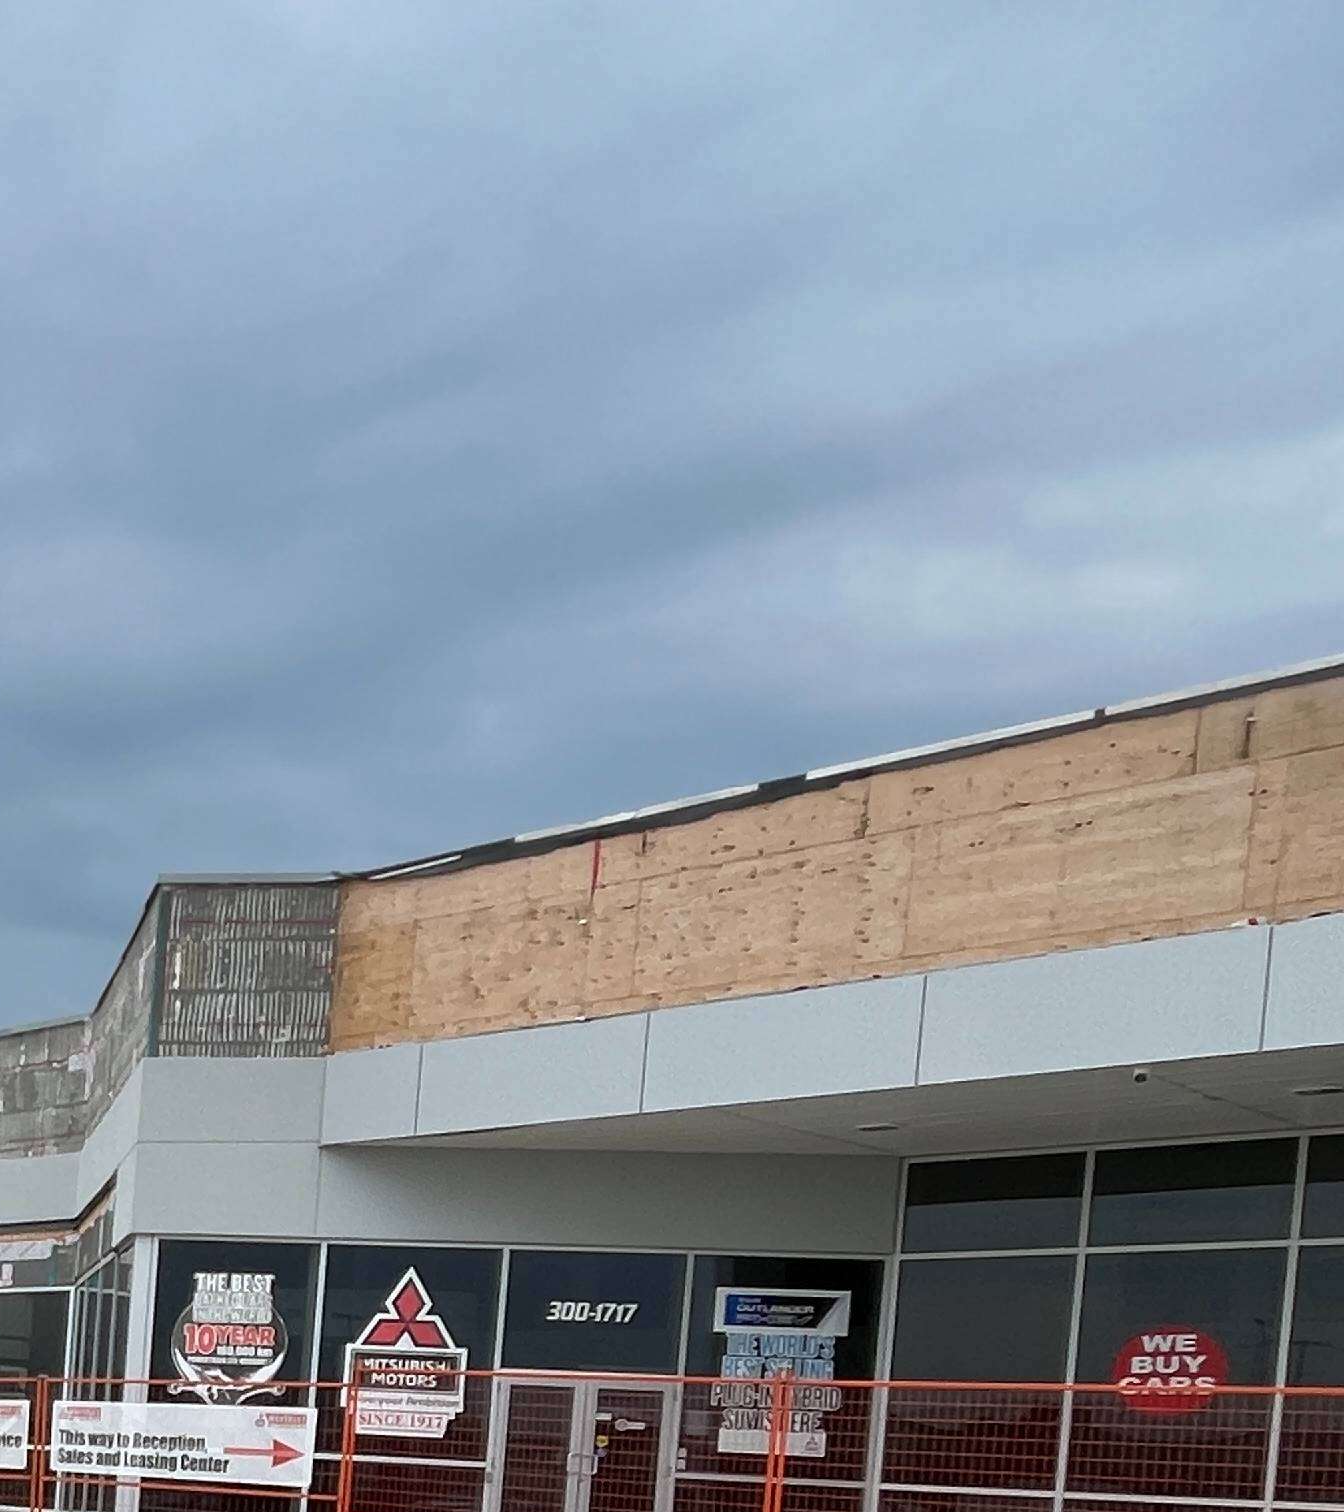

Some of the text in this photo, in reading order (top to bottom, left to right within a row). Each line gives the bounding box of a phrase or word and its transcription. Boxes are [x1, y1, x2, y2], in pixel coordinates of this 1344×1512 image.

[193, 1272, 276, 1293] THE BEST
[545, 1301, 639, 1323] 300-1717
[183, 1323, 218, 1355] 10
[215, 1325, 276, 1346] YEAR
[1141, 1334, 1198, 1352] WE
[1131, 1355, 1208, 1374] BUY
[372, 1373, 438, 1388] MOTORS
[1118, 1376, 1216, 1395] CARS
[359, 1413, 443, 1428] SINCE 1917
[59, 1429, 208, 1454] This way to Reception,
[58, 1449, 231, 1473] Sales and Leasing Center
